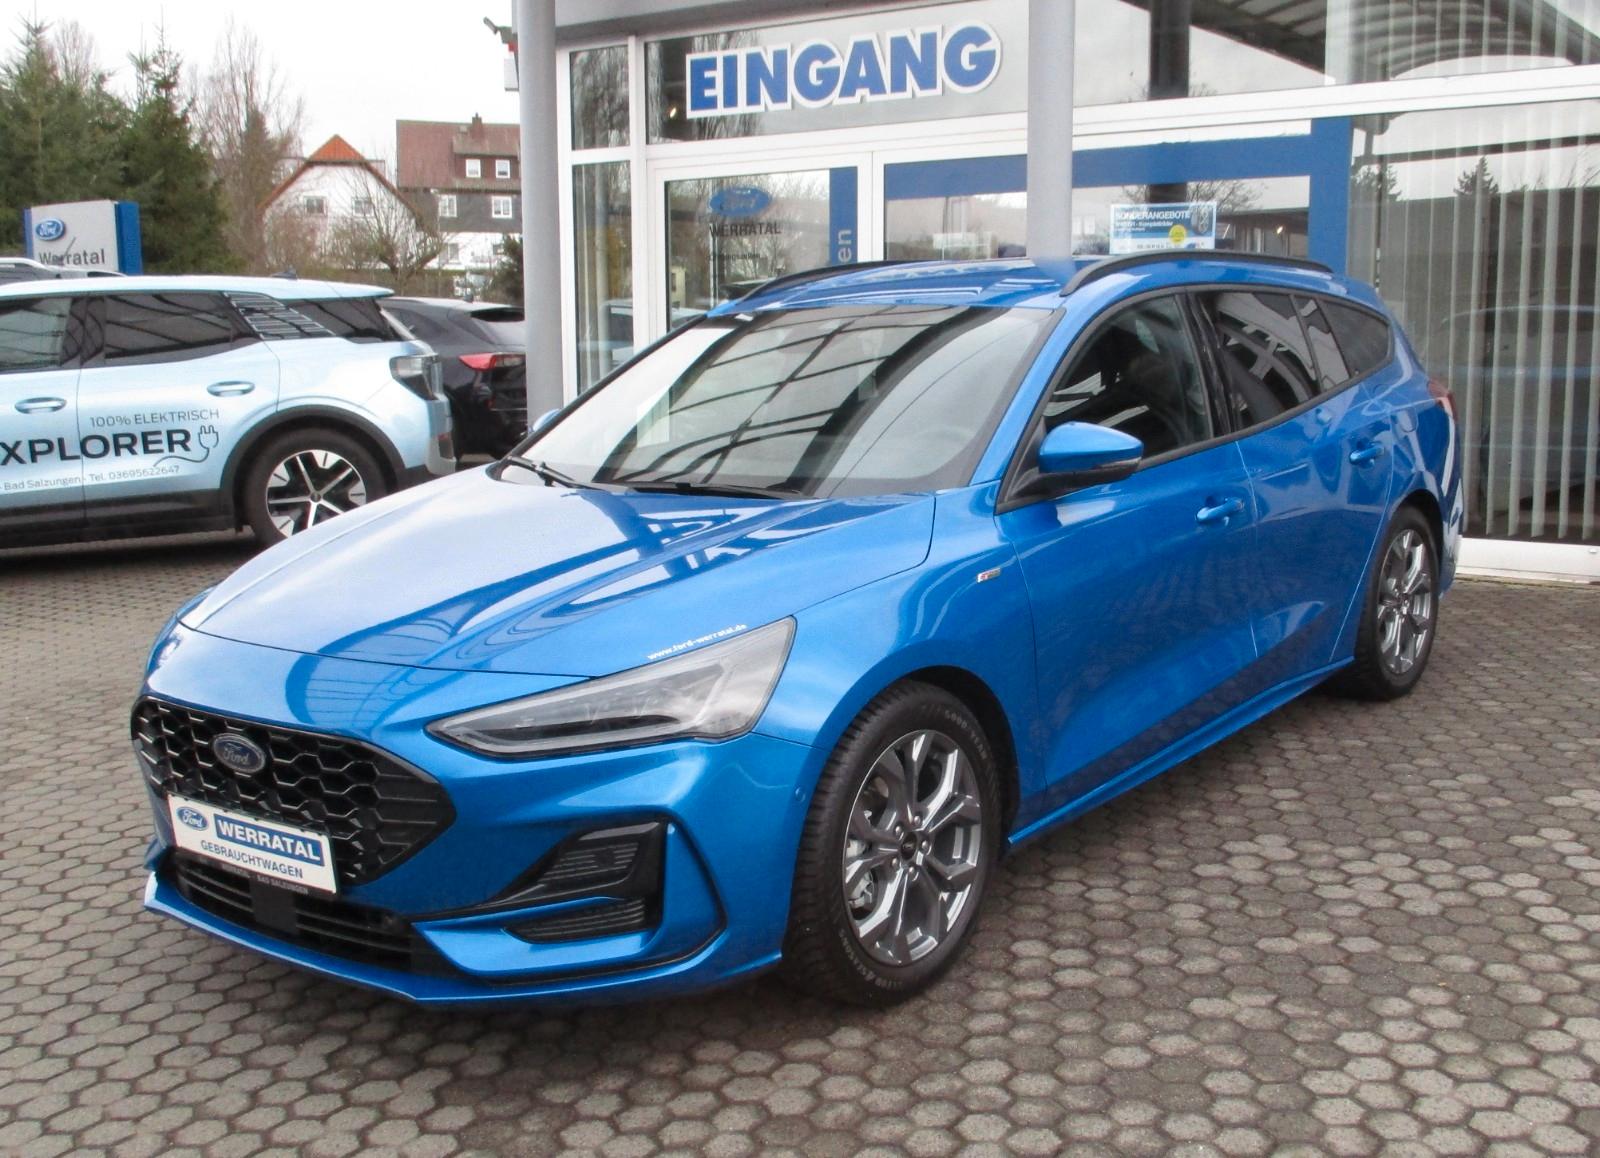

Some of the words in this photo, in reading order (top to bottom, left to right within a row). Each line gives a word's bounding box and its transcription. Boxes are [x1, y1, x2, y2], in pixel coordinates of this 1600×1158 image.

[688, 23, 999, 113] EINGANG
[709, 221, 782, 237] WERRATAL
[39, 249, 105, 265] Werratal
[90, 415, 131, 428] 100%
[134, 408, 220, 425] ELEKTRISCH
[0, 428, 191, 466] XPLORER
[4, 481, 25, 491] Bad
[27, 475, 81, 490] Salzungen
[647, 623, 747, 660] www.ford-werratal.de
[217, 819, 321, 861] WERRATAL
[201, 840, 303, 879] GEBRAUCHTWAGEN
